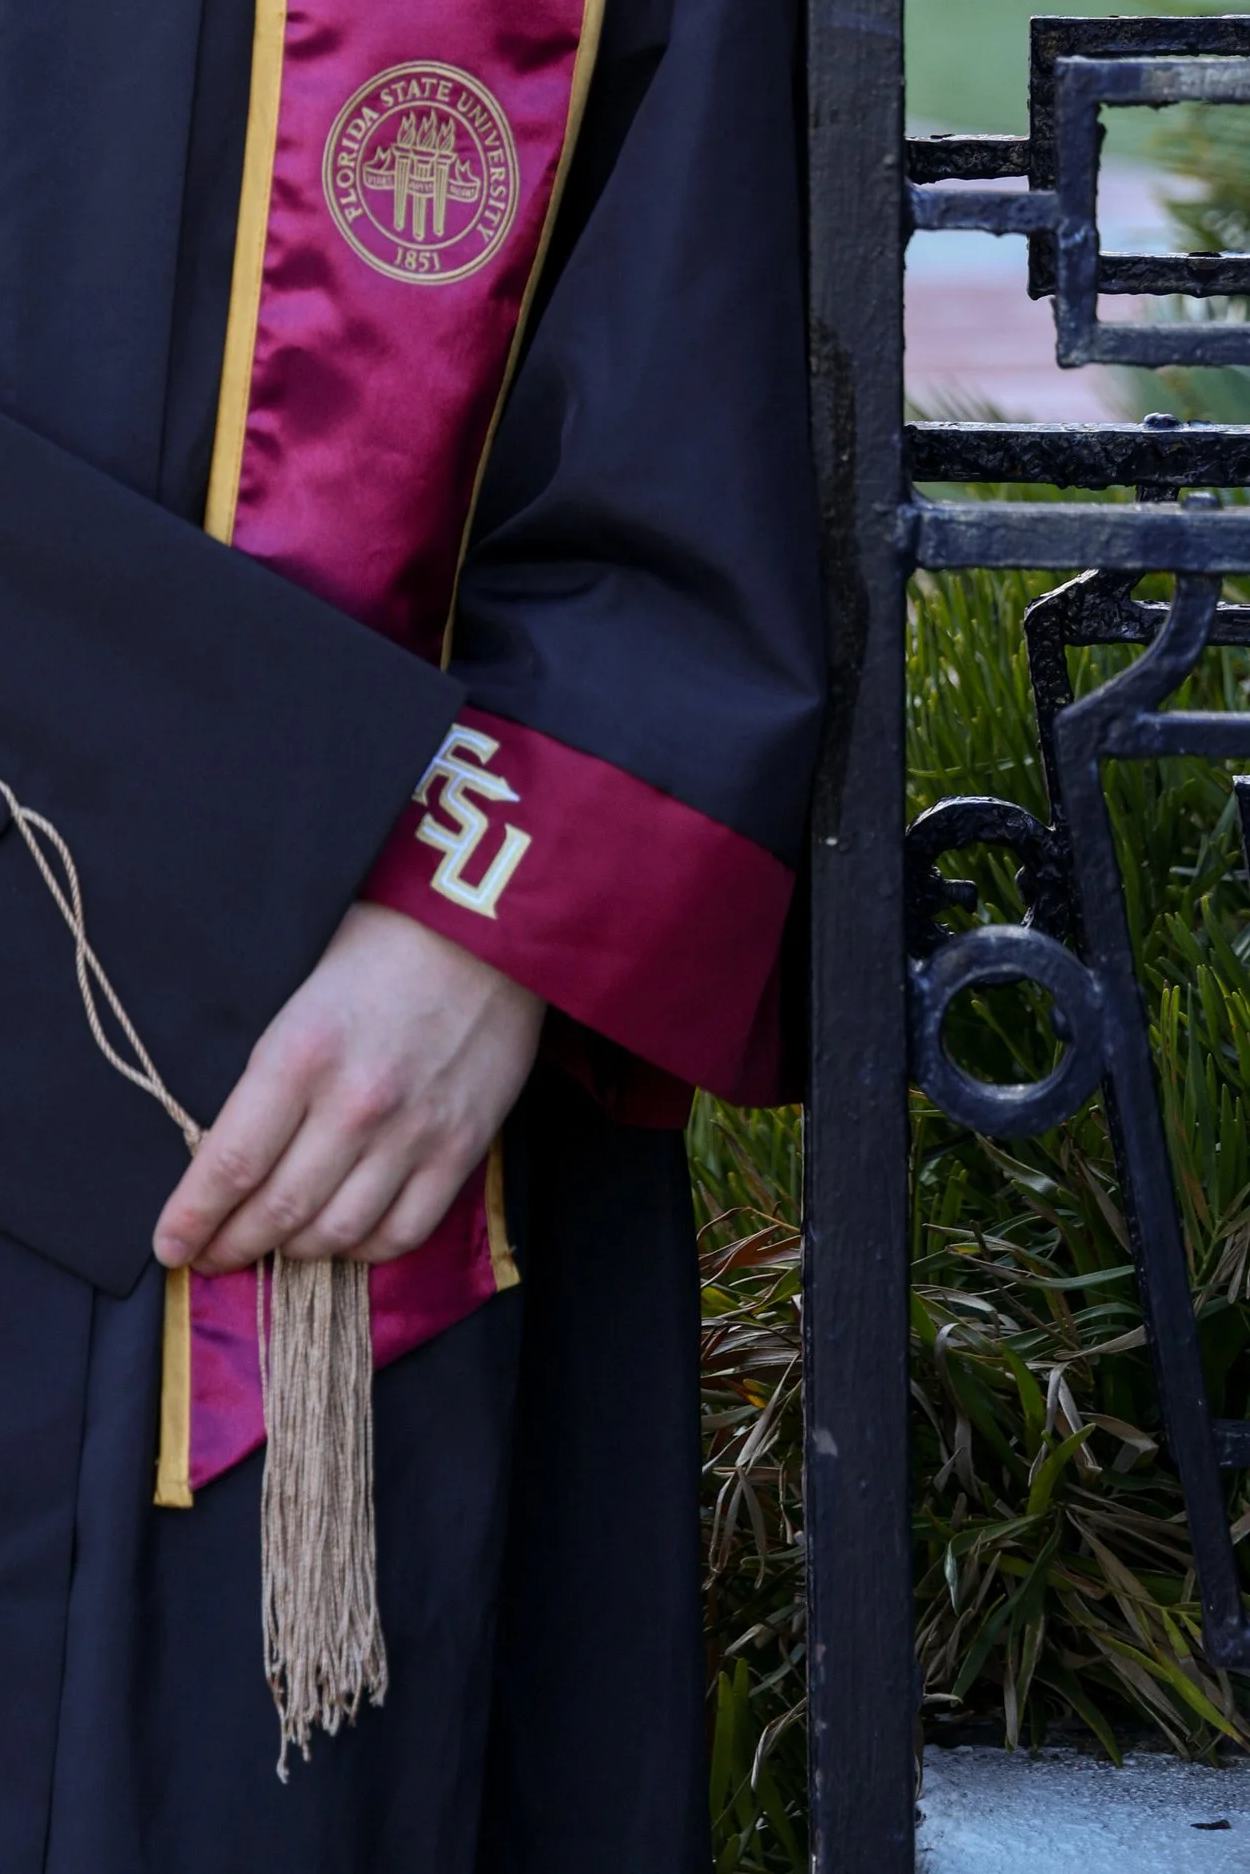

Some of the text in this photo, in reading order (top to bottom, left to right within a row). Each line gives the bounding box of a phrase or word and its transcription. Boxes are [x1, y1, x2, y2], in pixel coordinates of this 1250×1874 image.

[336, 77, 505, 242] FLORIDA STATE UNIVERSITY
[395, 249, 441, 272] 1851
[411, 723, 532, 919] FSU
